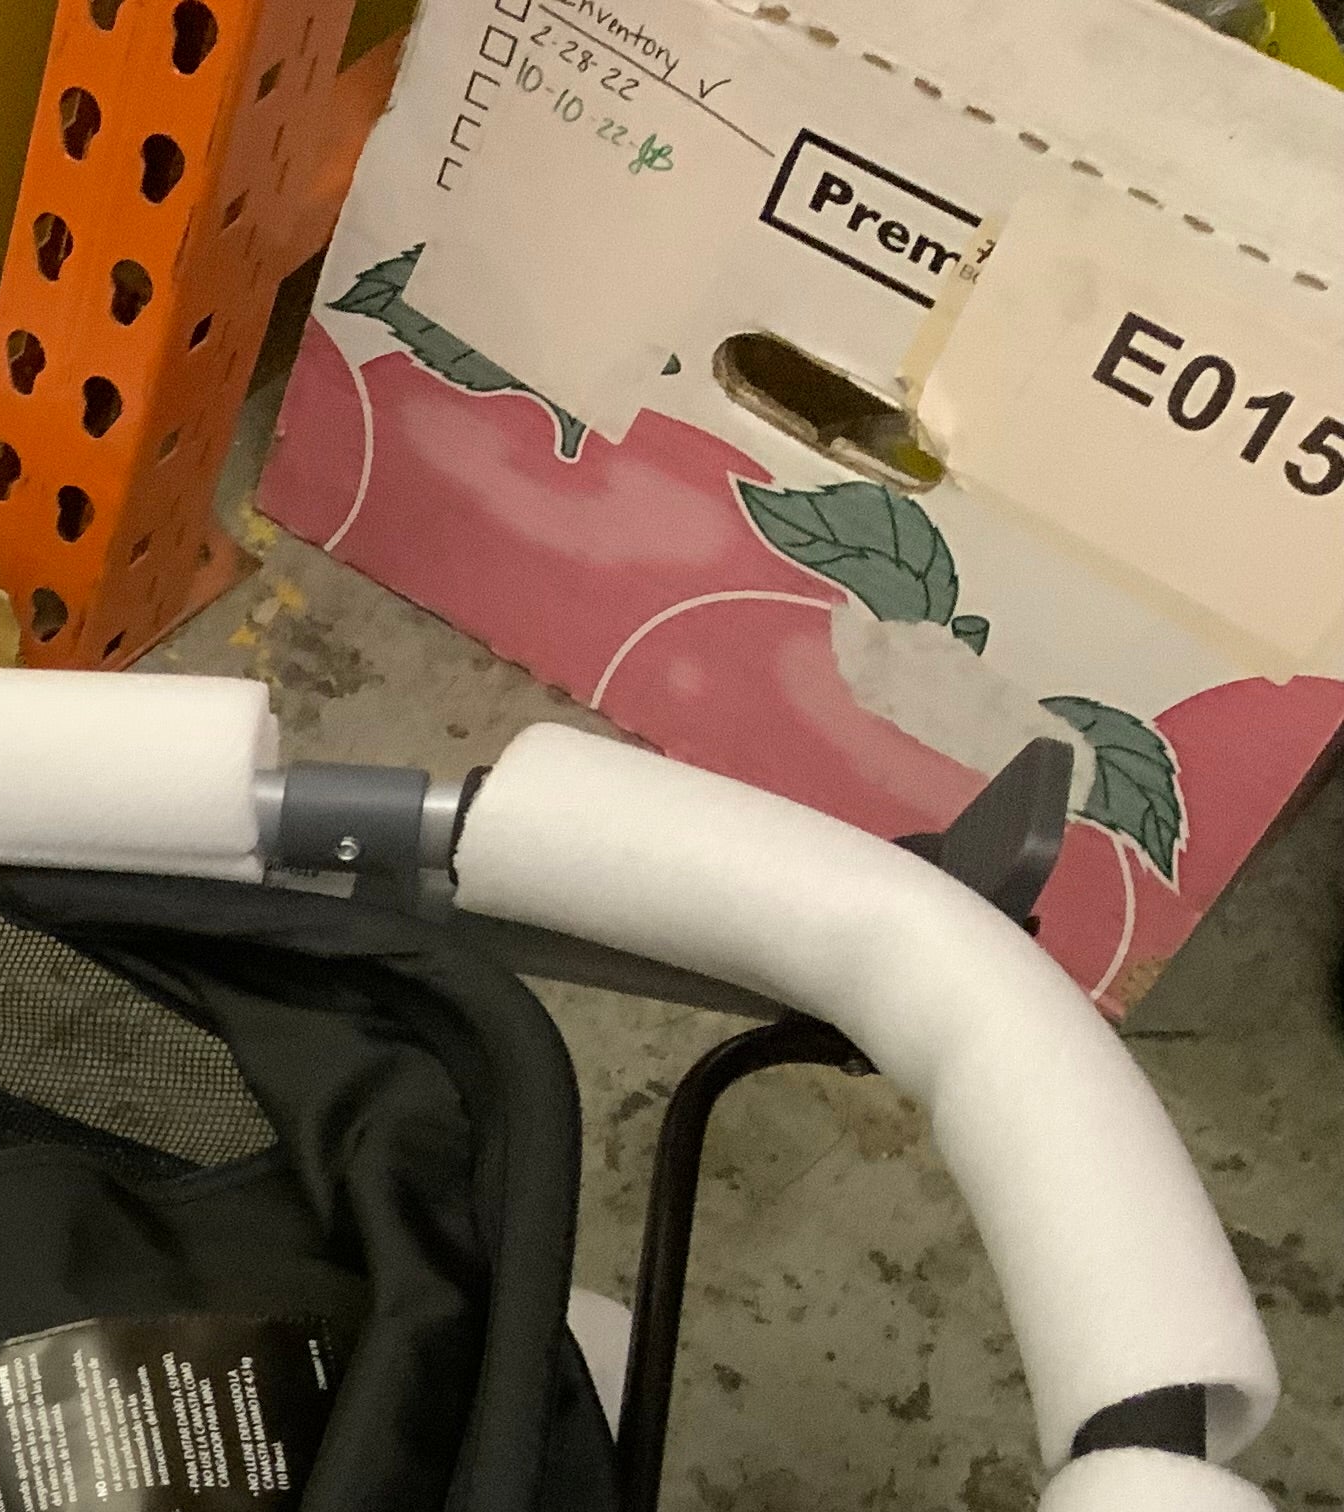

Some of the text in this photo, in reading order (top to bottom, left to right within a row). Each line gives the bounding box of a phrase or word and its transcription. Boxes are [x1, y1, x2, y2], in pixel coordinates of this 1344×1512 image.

[556, 0, 680, 80] nventory
[1091, 310, 1344, 497] E015
[179, 1361, 197, 1391] COMO
[186, 1389, 206, 1435] CANASTA
[203, 1404, 220, 1431] PARA
[177, 1426, 195, 1460] EVITAR
[194, 1434, 208, 1449] LA
[185, 1459, 200, 1488] PARA
[209, 1430, 230, 1488] CARGADOR
[255, 1440, 274, 1490] CANASTA
[94, 1479, 108, 1497] NO
[201, 1468, 215, 1487] NO
[246, 1472, 260, 1491] NO
